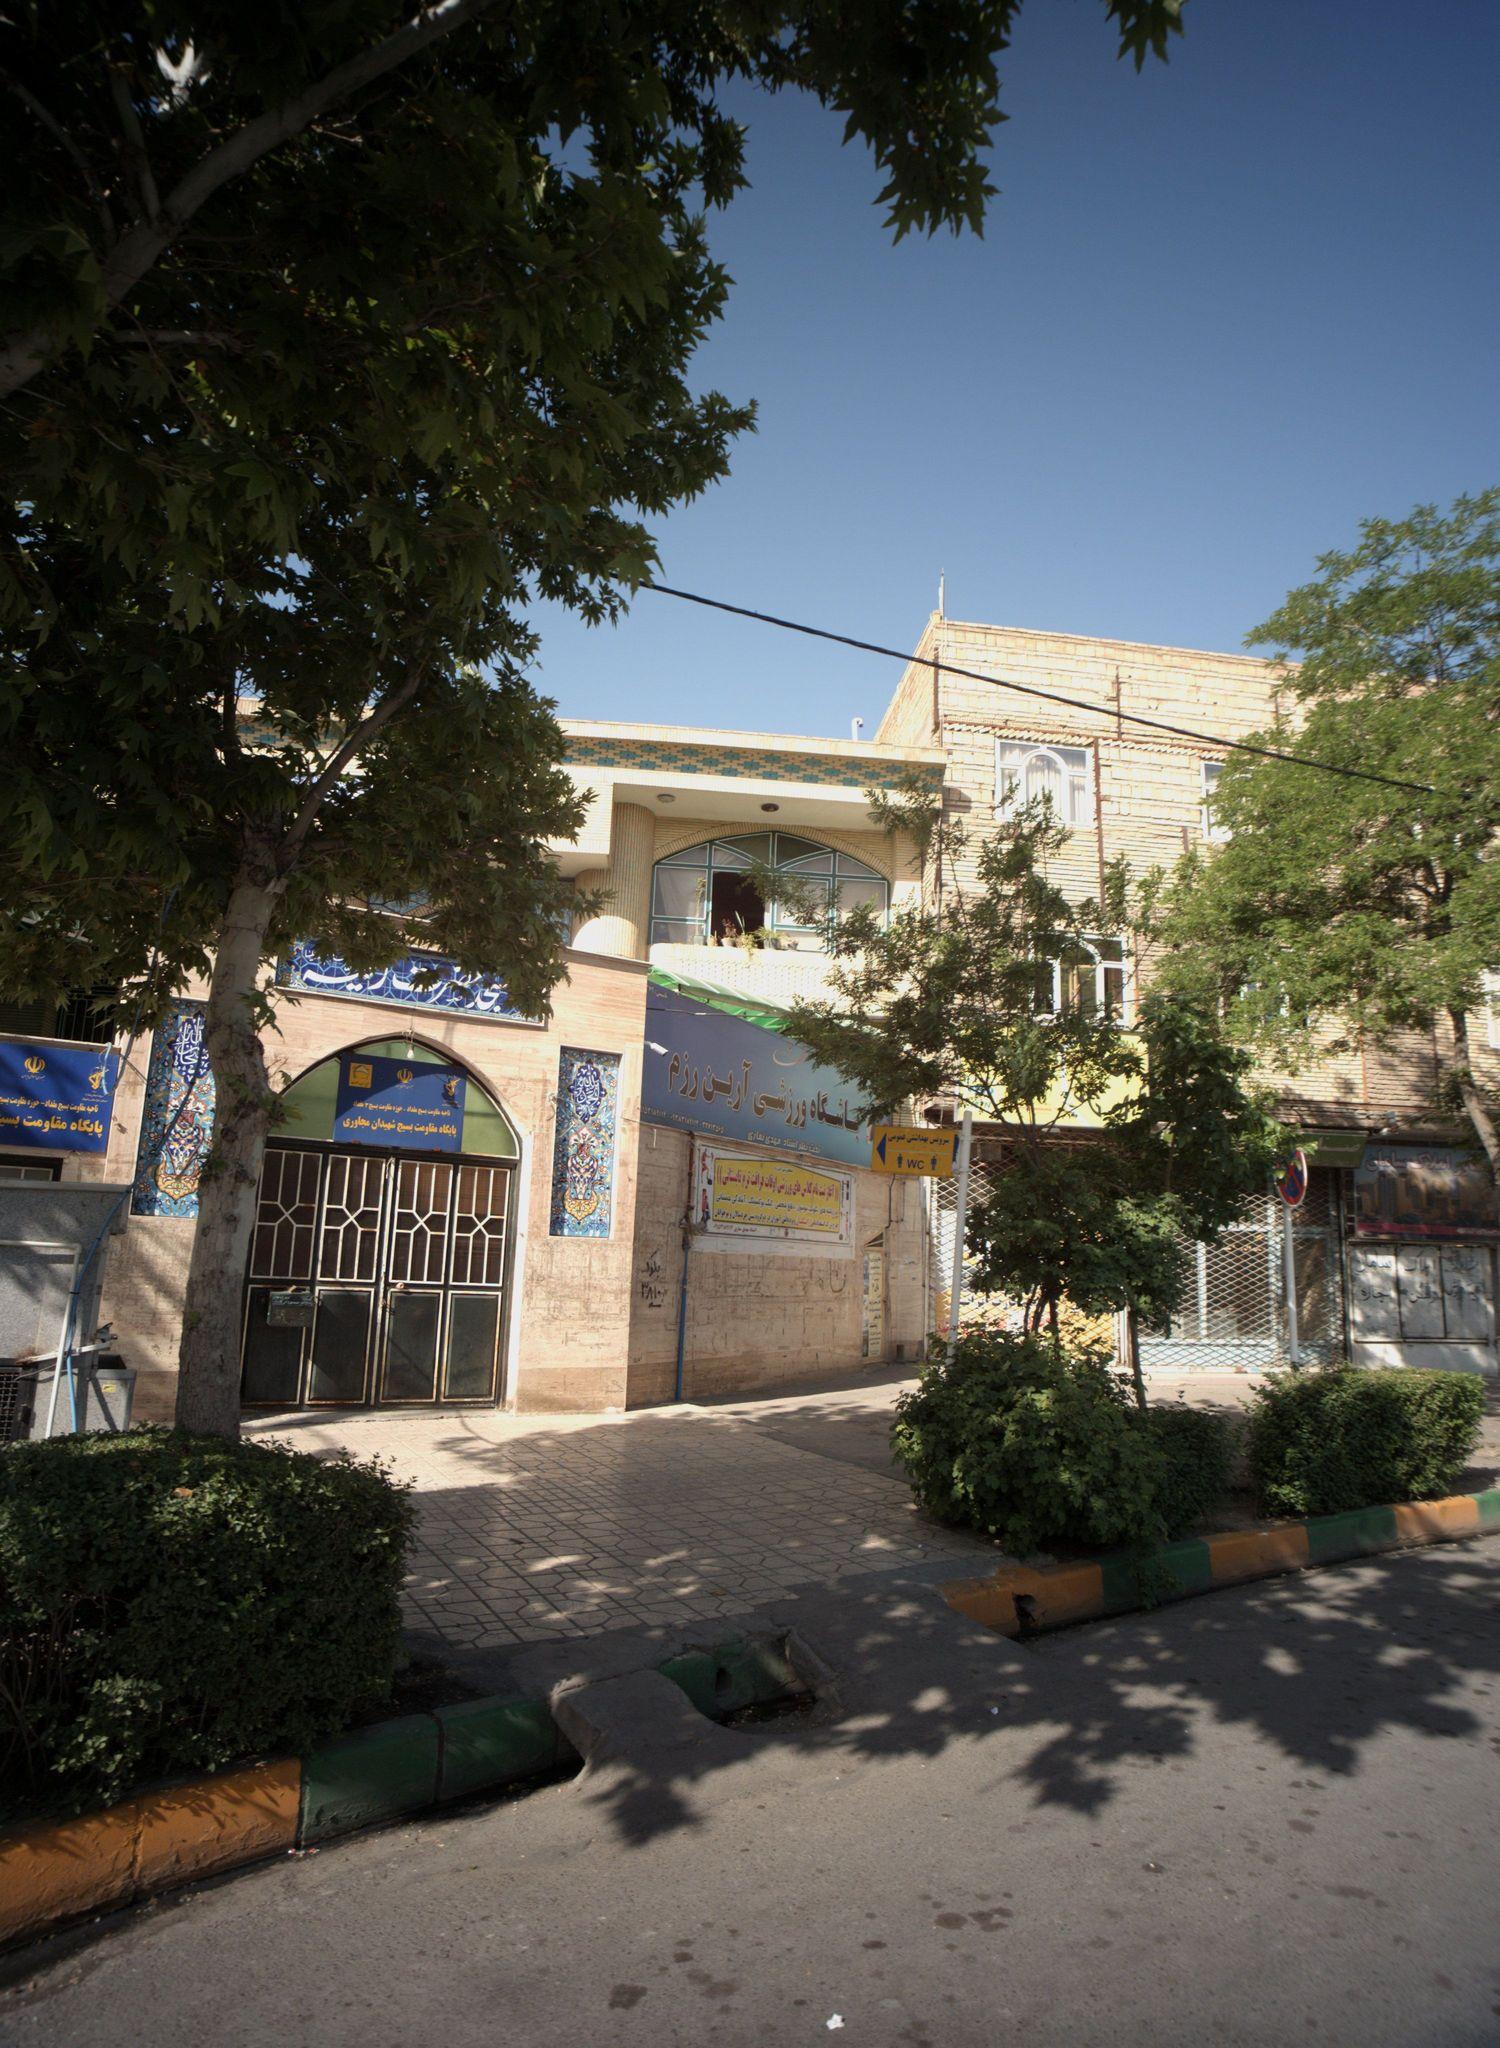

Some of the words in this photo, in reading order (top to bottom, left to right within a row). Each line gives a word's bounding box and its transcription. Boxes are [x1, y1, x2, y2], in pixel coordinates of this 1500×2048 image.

[668, 1051, 698, 1100] رزم
[701, 1058, 752, 1113] آرین
[57, 1102, 70, 1112] بسیج
[69, 1102, 86, 1113] مقاومت
[753, 1077, 807, 1129] ورزشی
[22, 1115, 67, 1132] مقاومت
[70, 1118, 103, 1138] پایگاه
[371, 1118, 396, 1131] شهیدان
[396, 1121, 414, 1133] بسیج
[414, 1121, 439, 1135] مقاومت
[438, 1122, 457, 1137] پایگاه
[907, 1159, 925, 1170] WC
